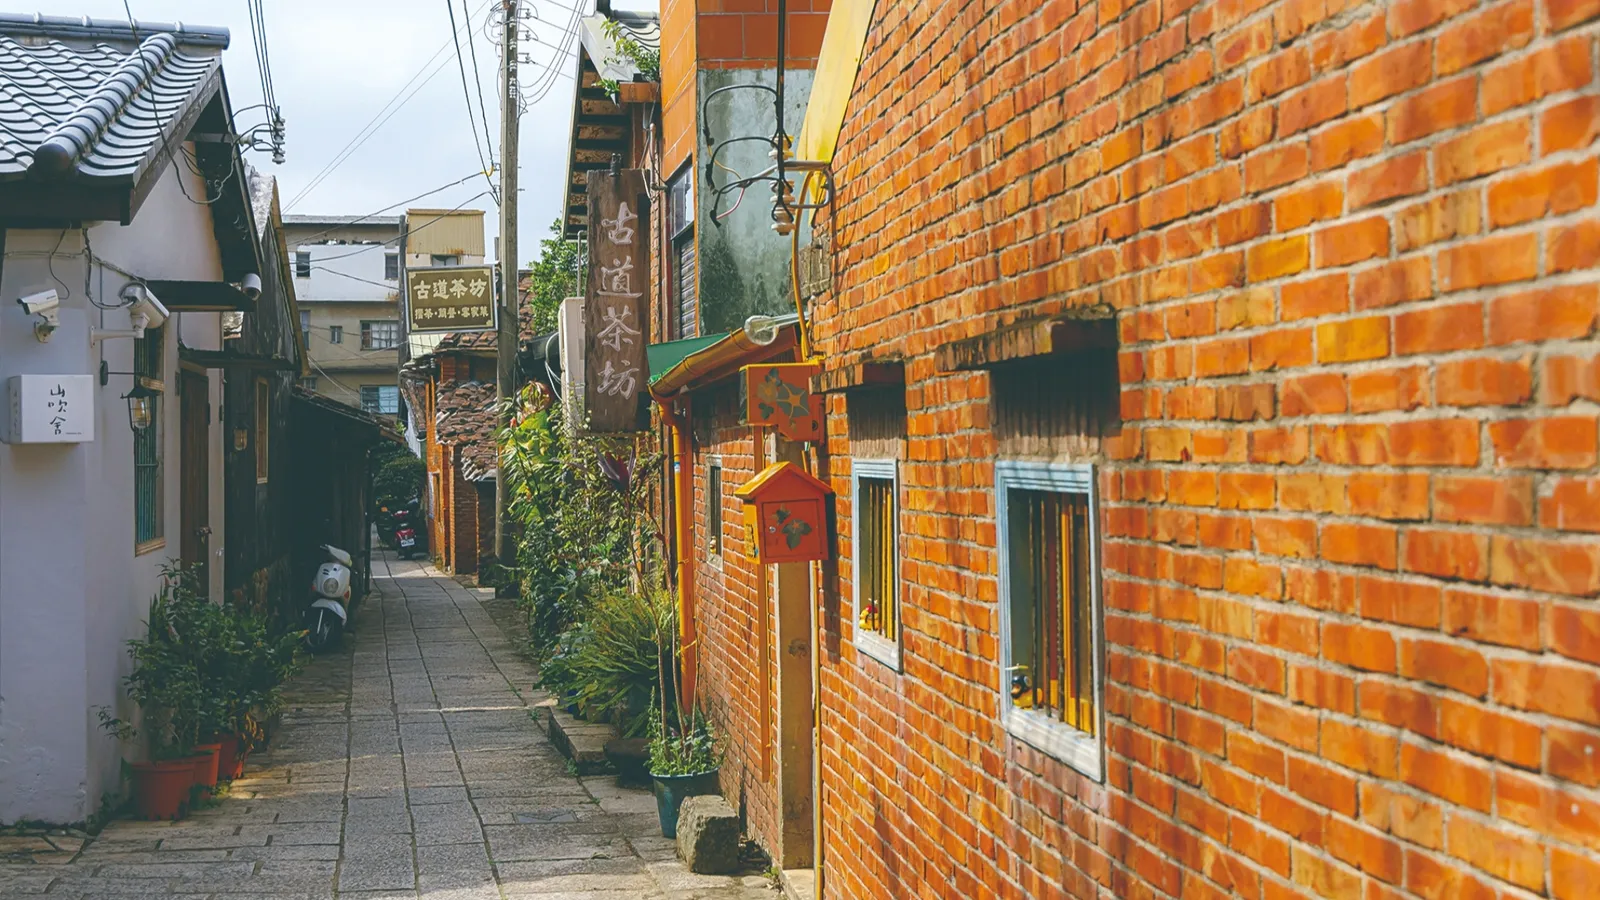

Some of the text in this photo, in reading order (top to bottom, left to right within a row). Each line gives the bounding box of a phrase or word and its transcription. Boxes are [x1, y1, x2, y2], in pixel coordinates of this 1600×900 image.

[413, 278, 487, 299] 古道茶坊
[597, 201, 643, 399] 古道茶坊
